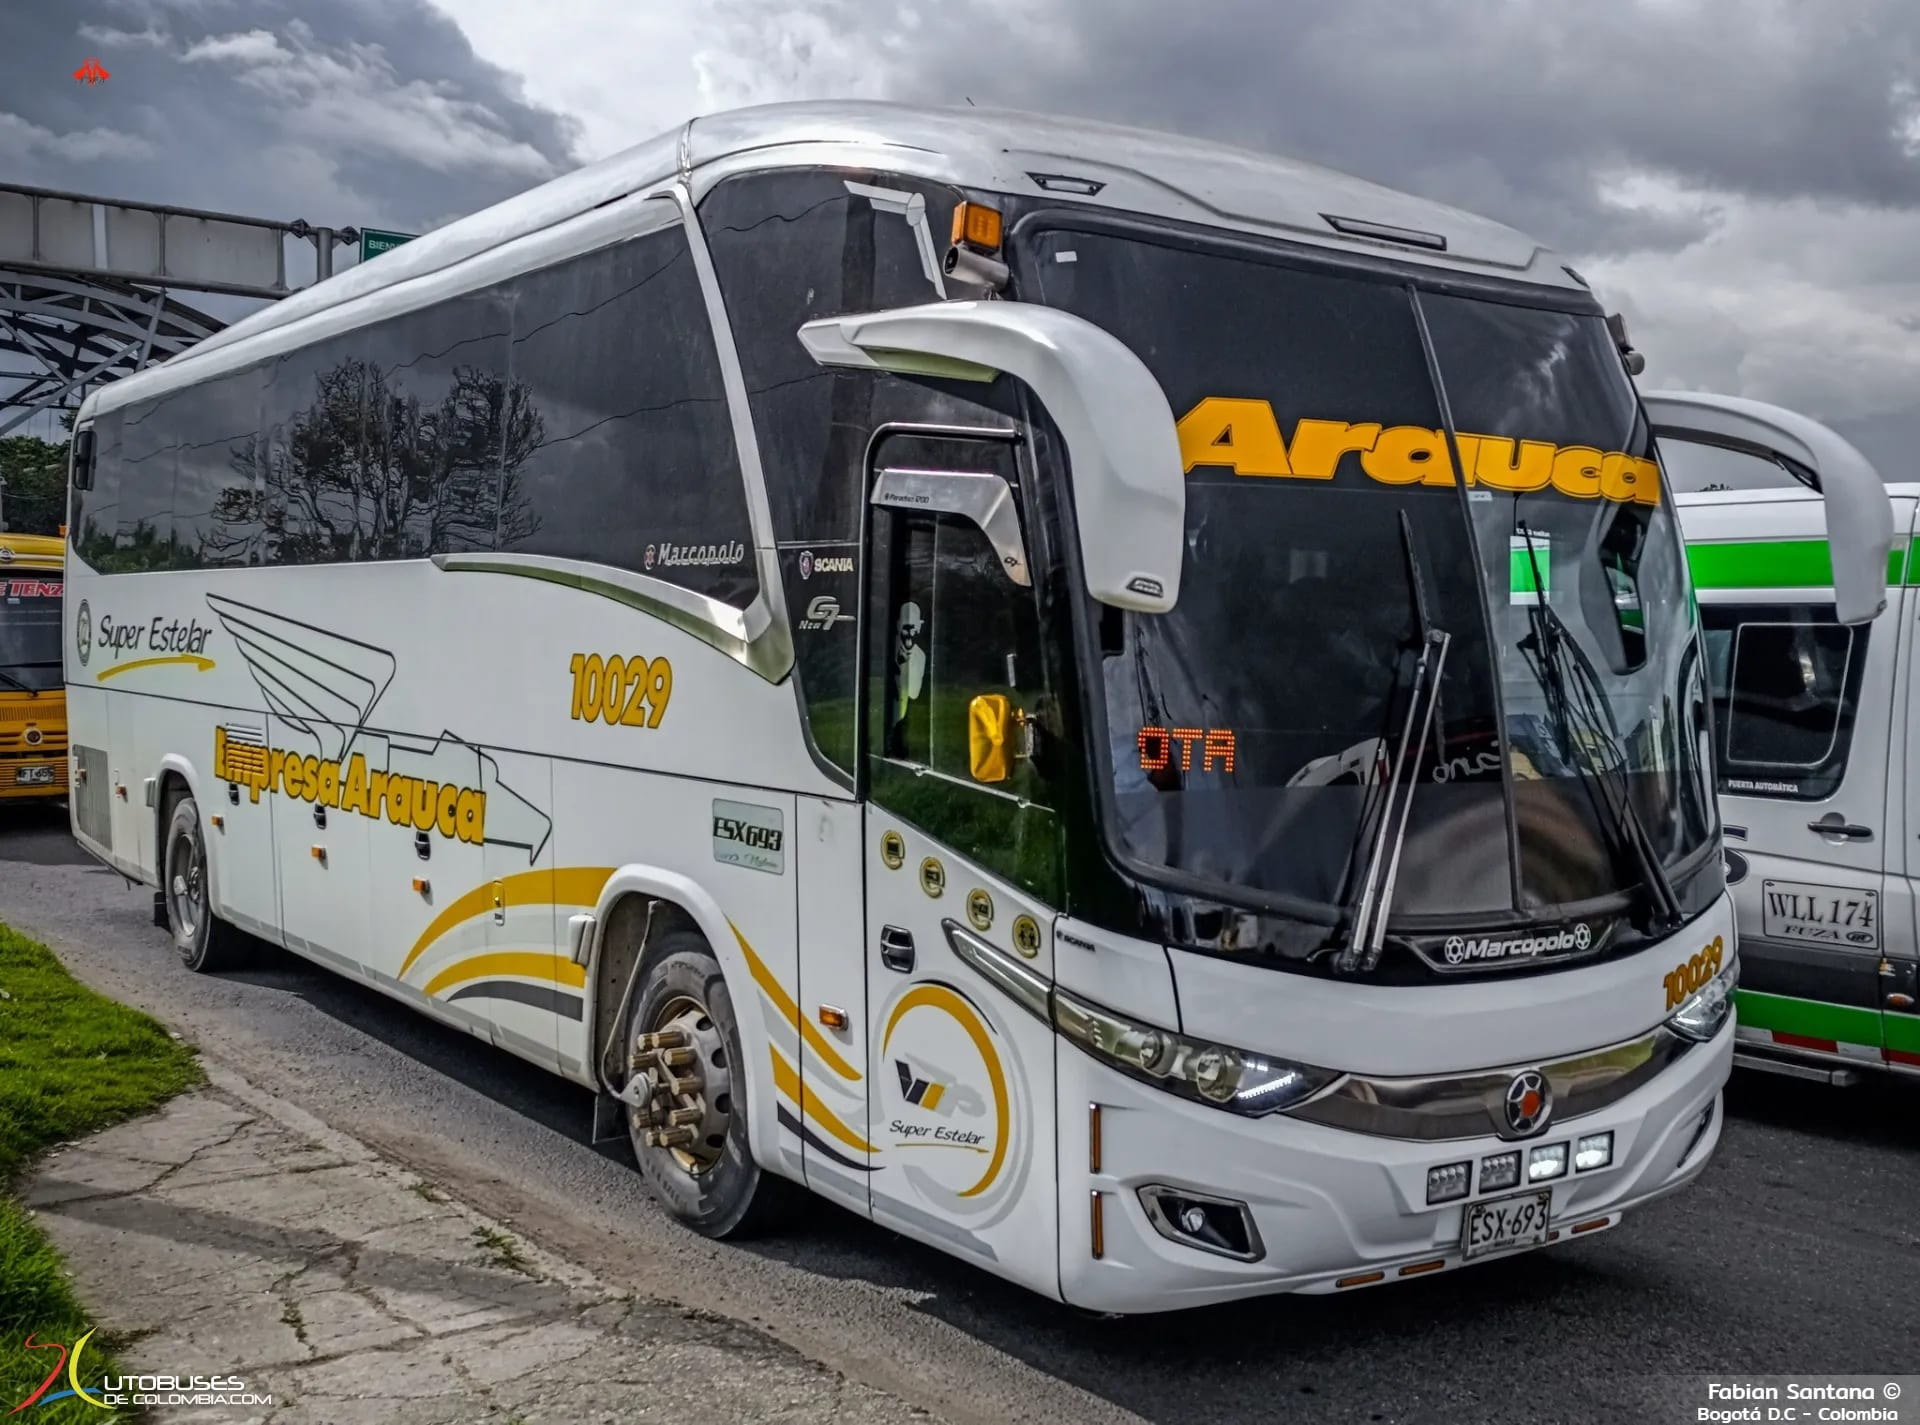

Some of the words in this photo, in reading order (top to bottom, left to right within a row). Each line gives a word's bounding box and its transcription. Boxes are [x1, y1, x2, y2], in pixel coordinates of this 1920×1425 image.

[1175, 397, 1661, 506] Arauca
[657, 540, 745, 567] Marcopolo
[814, 557, 854, 573] SCANIA
[97, 614, 145, 660] Super
[149, 616, 213, 655] Estelar
[570, 652, 673, 730] 10029
[341, 752, 487, 847] Arauca
[1728, 779, 1754, 790] PUERTA
[713, 816, 783, 852] ESX693
[1767, 892, 1824, 924] WLL
[1828, 898, 1875, 928] 174
[1464, 930, 1575, 960] Marcopolo
[1663, 934, 1724, 1013] 10029
[889, 1119, 932, 1139] Super
[934, 1126, 986, 1146] Estelar
